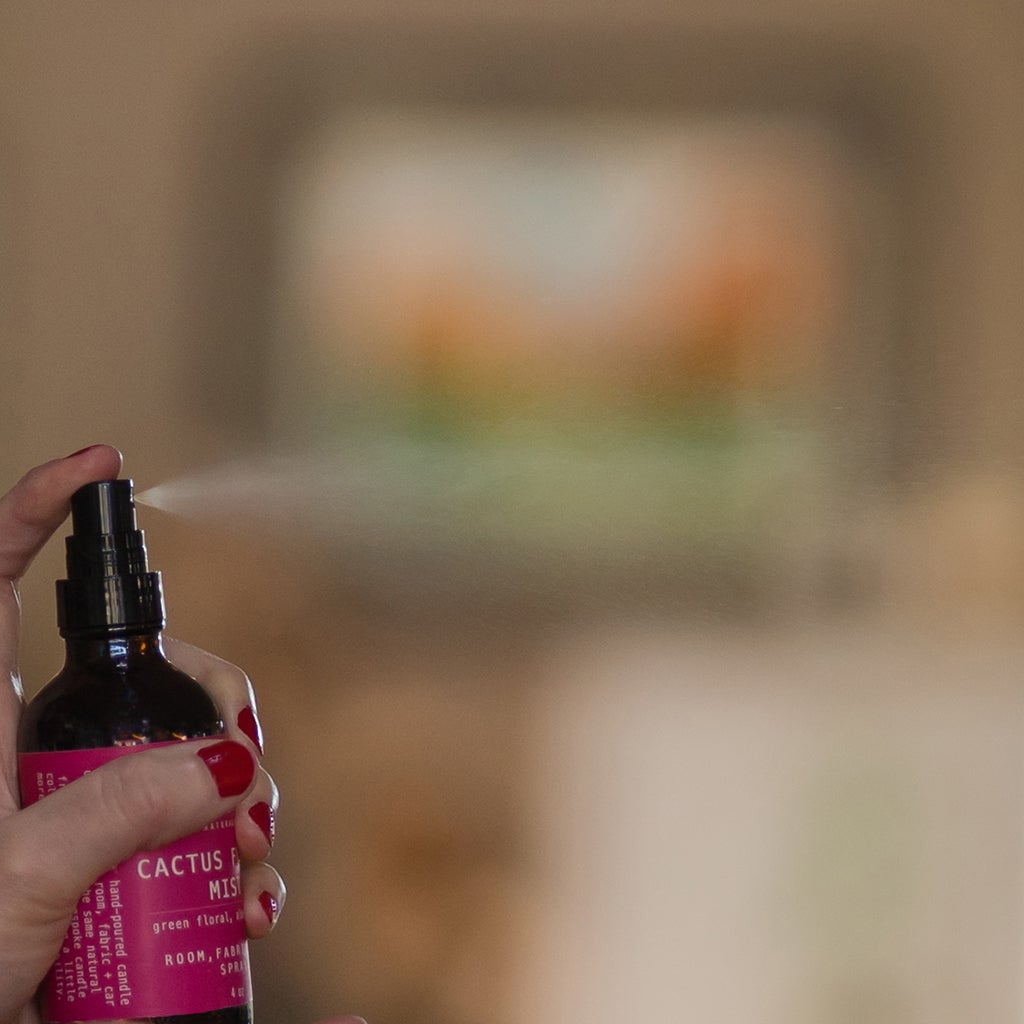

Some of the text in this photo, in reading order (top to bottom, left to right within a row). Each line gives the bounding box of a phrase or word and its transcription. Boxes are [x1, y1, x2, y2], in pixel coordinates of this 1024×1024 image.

[137, 849, 223, 879] CACTUS
[95, 883, 105, 914] room,
[81, 889, 102, 993] he same natural
[153, 918, 190, 935] green
[197, 911, 233, 927] floral,
[98, 924, 112, 965] fabric
[109, 880, 132, 1006] hand-poured candle
[64, 961, 76, 1002] little
[74, 956, 88, 998] candle
[230, 986, 236, 998] 4
[104, 986, 115, 1006] car
